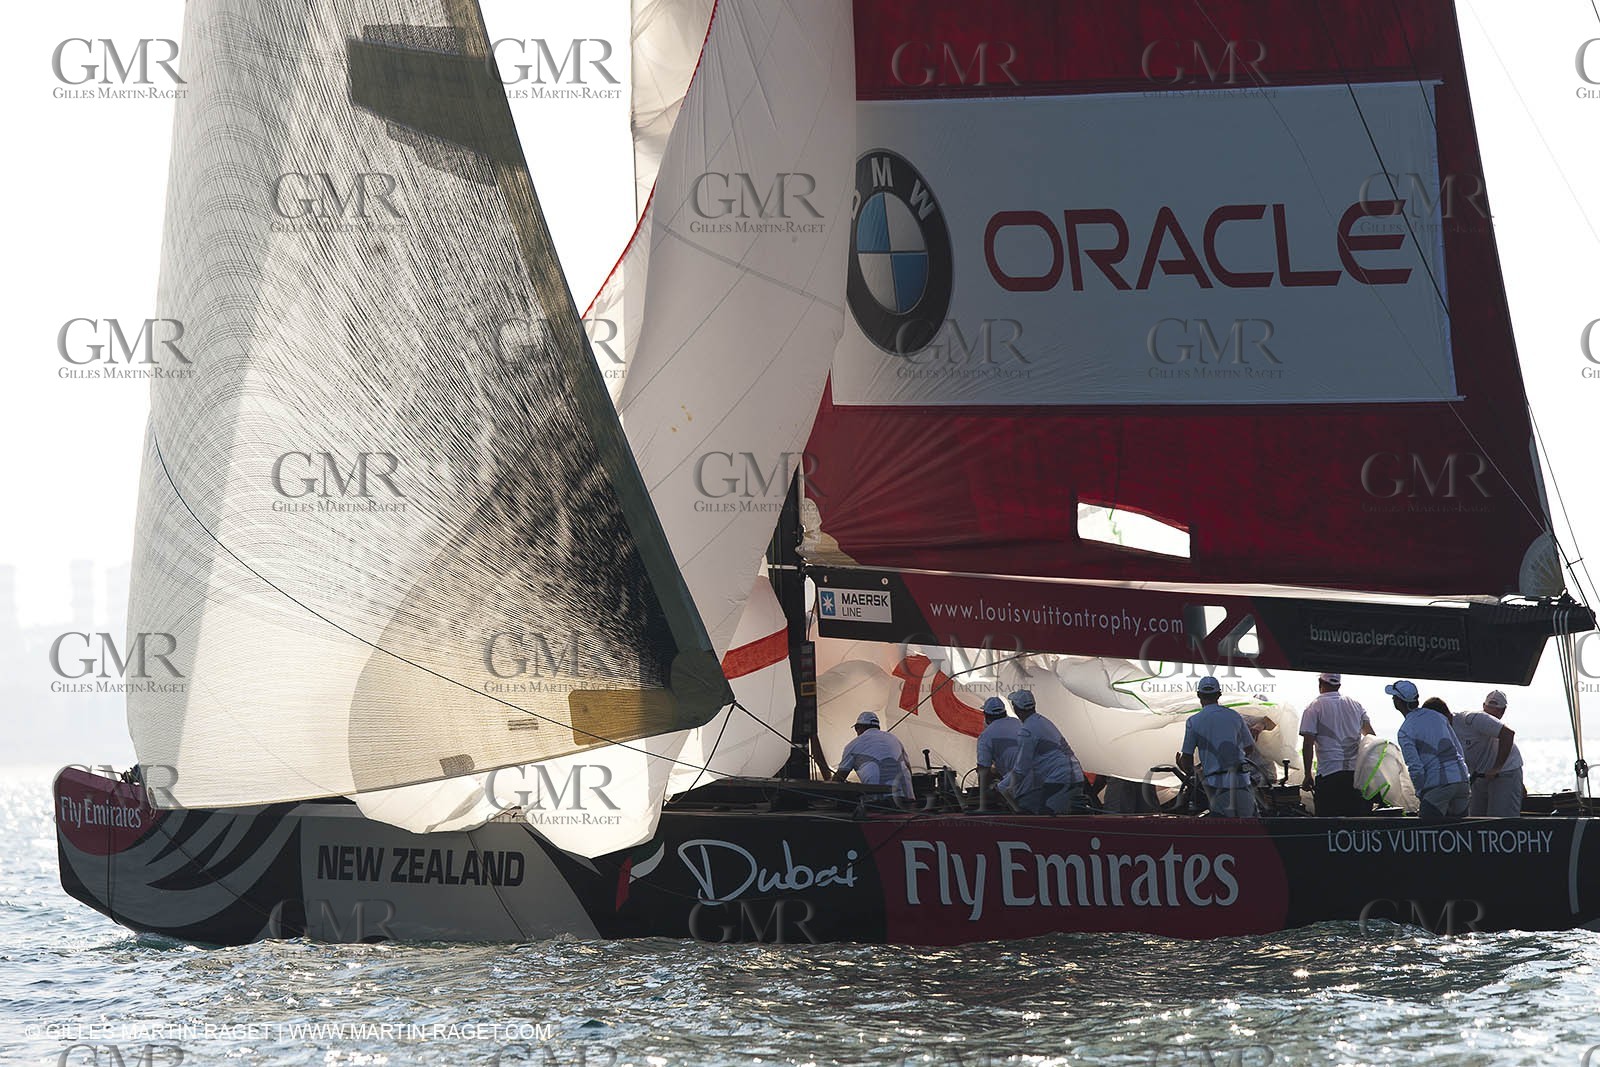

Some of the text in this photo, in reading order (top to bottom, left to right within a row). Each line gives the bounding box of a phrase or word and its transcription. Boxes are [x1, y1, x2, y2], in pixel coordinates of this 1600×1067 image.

[983, 200, 1412, 292] ORACLE
[841, 592, 889, 608] MAERSK
[842, 607, 862, 618] LINE
[930, 599, 1184, 636] www.louisvuittontrophy.com
[1310, 624, 1461, 651] bmworacleracing.com
[61, 796, 142, 829] Fly Emirates
[1328, 829, 1553, 853] LOUIS VUITTON TROPHY
[317, 845, 525, 887] NEW ZEALAND
[677, 839, 858, 906] Dubai
[902, 837, 1239, 921] Fly Emirates
